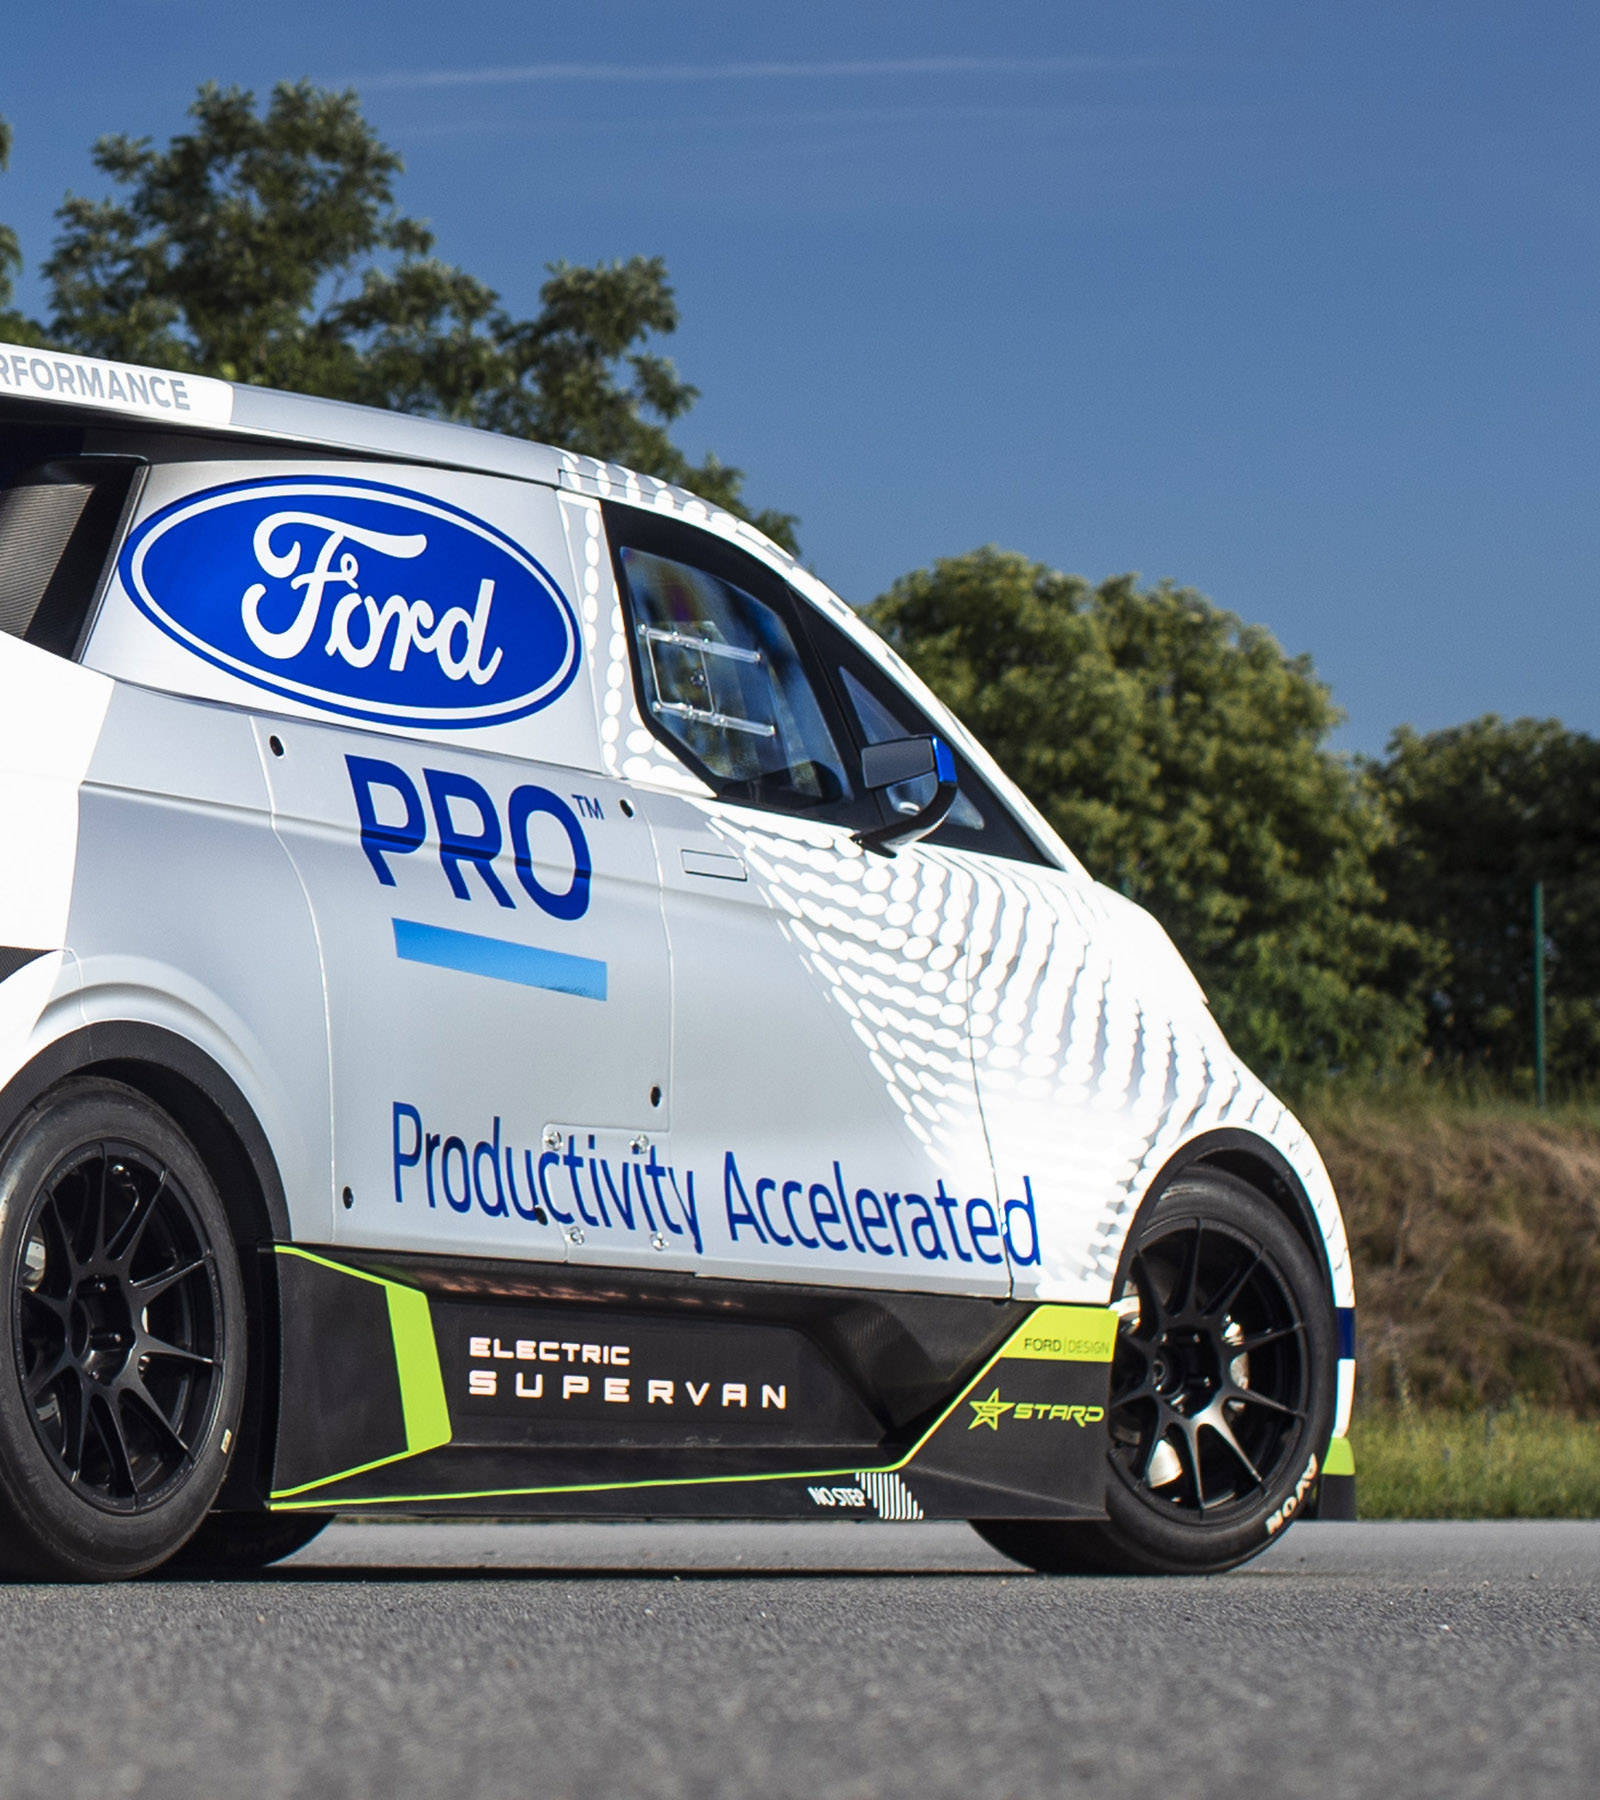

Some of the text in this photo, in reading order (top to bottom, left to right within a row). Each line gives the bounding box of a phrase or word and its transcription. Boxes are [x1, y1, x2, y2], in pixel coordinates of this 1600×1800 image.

[241, 511, 504, 685] Ford
[344, 753, 593, 921] PRO
[392, 1101, 1043, 1268] Productivity Accelerated
[469, 1336, 631, 1366] ELECTRIC
[1024, 1337, 1110, 1356] FORD DESIGN
[469, 1369, 787, 1410] SUPERVAN
[1012, 1402, 1105, 1429] STARD
[807, 1486, 866, 1507] NO STEP
